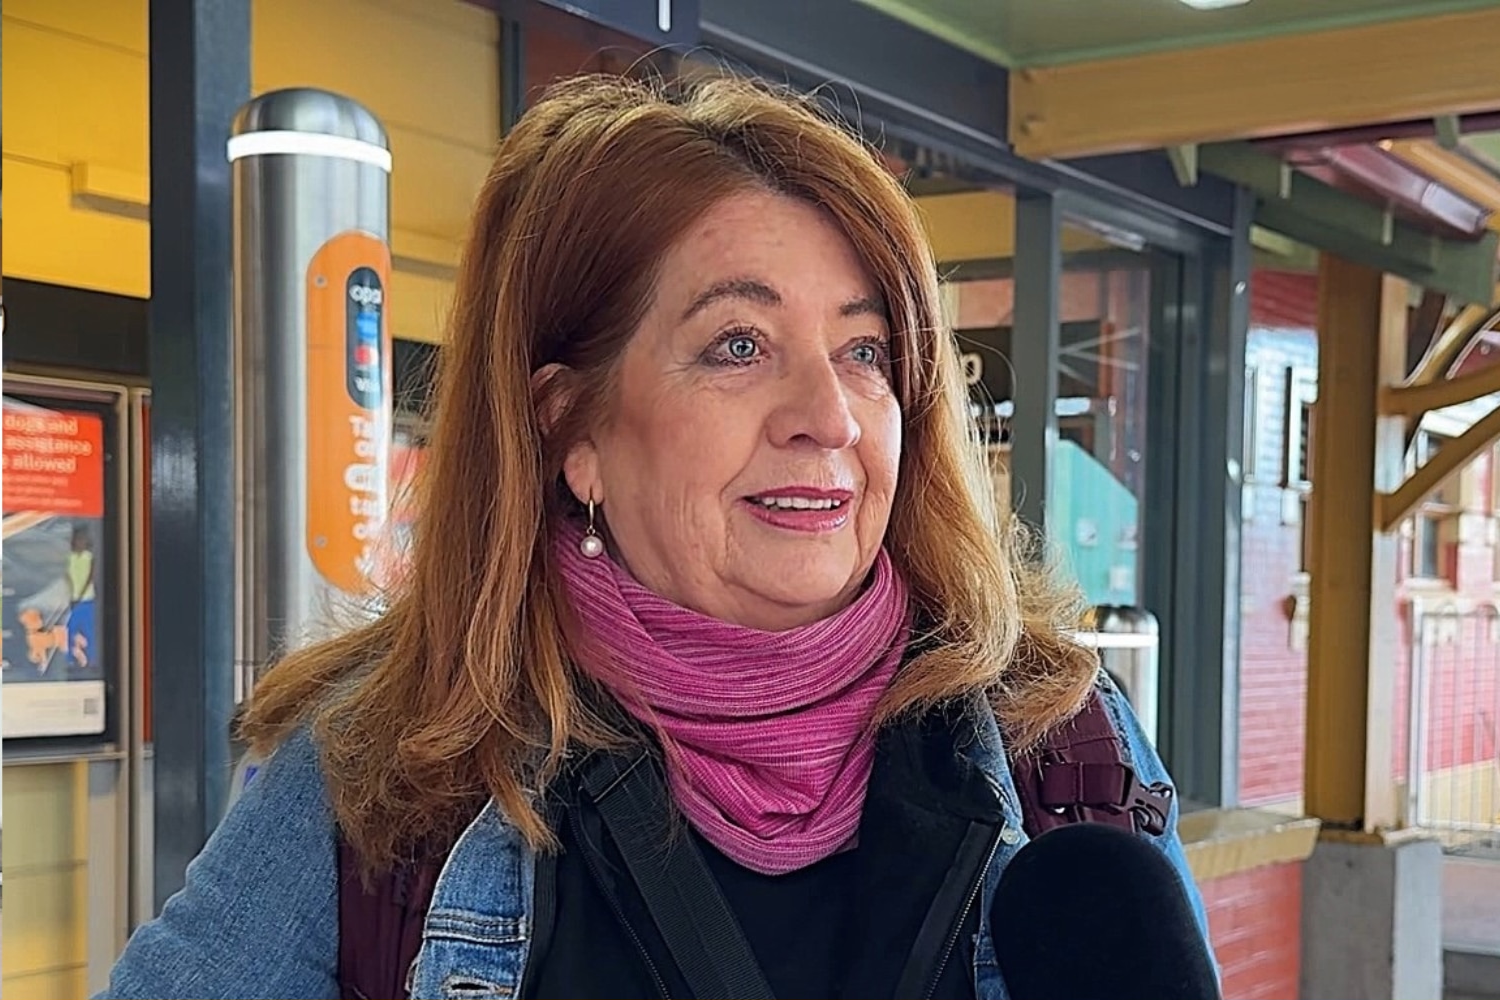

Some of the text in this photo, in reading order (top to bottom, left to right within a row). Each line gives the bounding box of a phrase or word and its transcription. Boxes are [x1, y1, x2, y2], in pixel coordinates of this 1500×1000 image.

[47, 416, 78, 436] and
[3, 434, 93, 457] assistance
[12, 453, 77, 474] allowed
